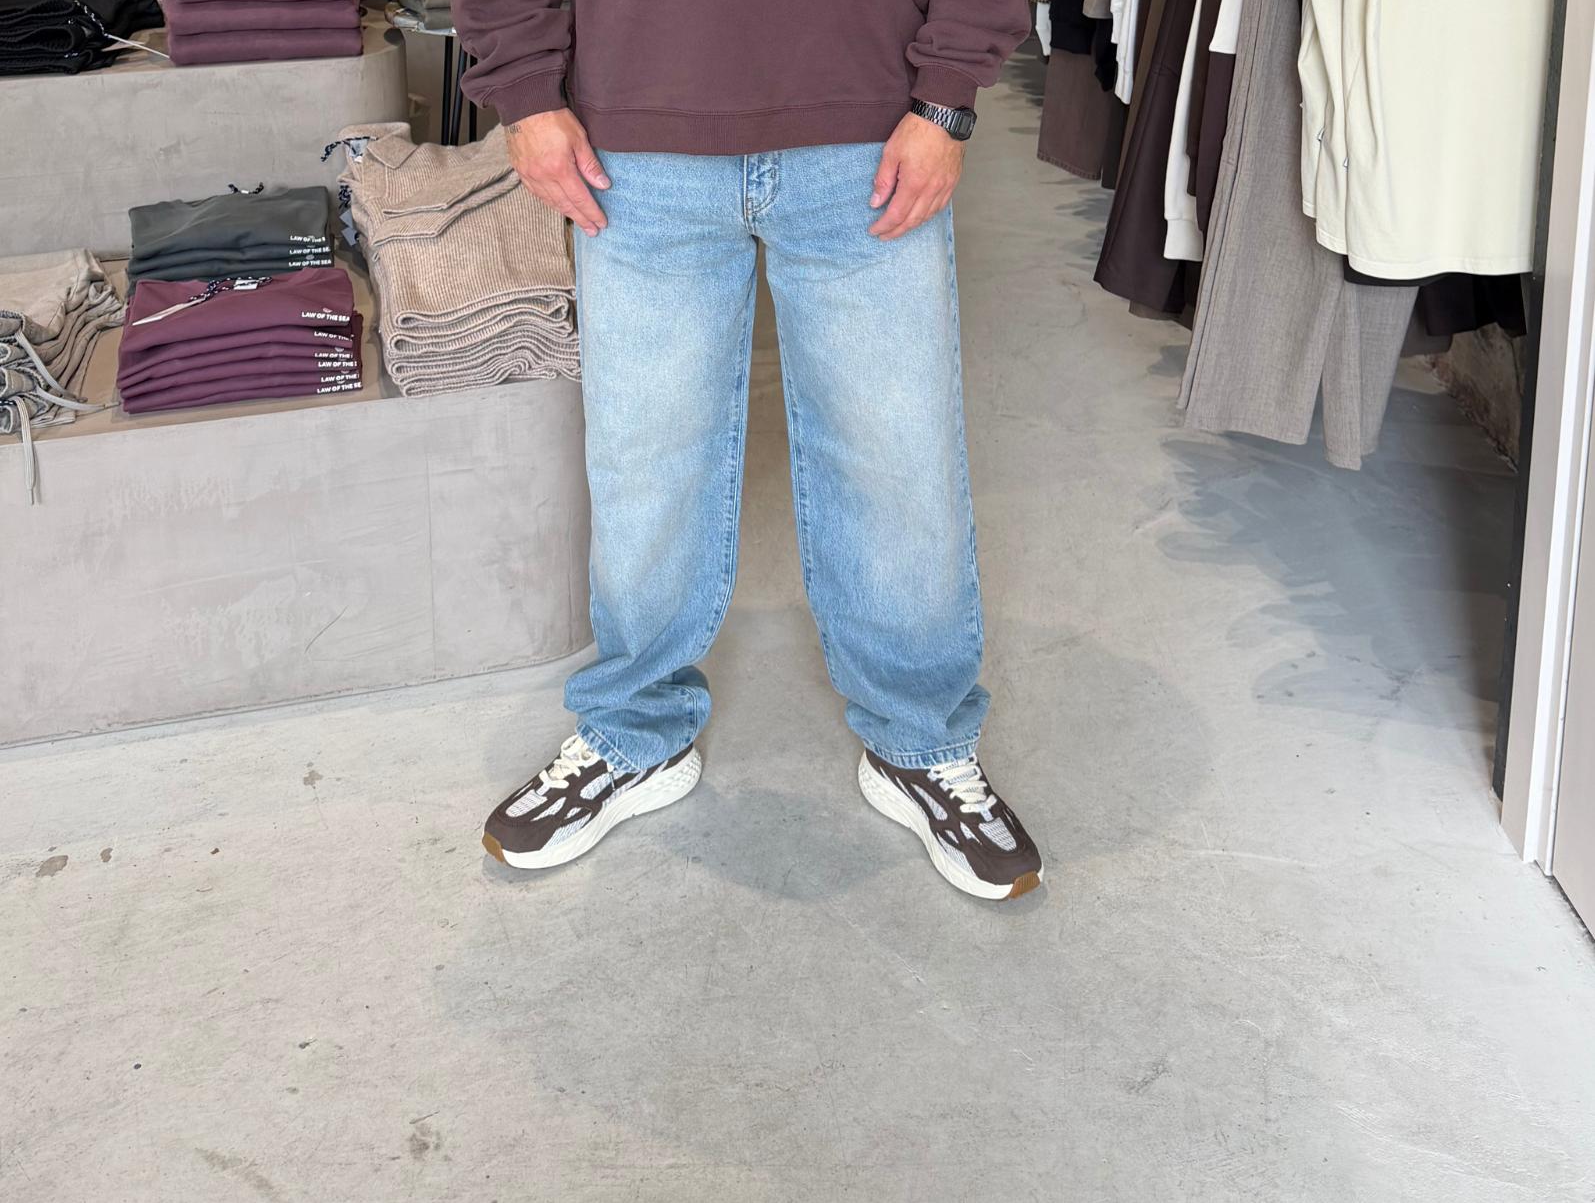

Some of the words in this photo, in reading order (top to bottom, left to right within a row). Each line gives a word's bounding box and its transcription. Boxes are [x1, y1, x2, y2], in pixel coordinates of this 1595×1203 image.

[326, 313, 338, 321] THE
[338, 314, 350, 322] SEA
[321, 375, 336, 383] LAW
[317, 386, 332, 394] LAW
